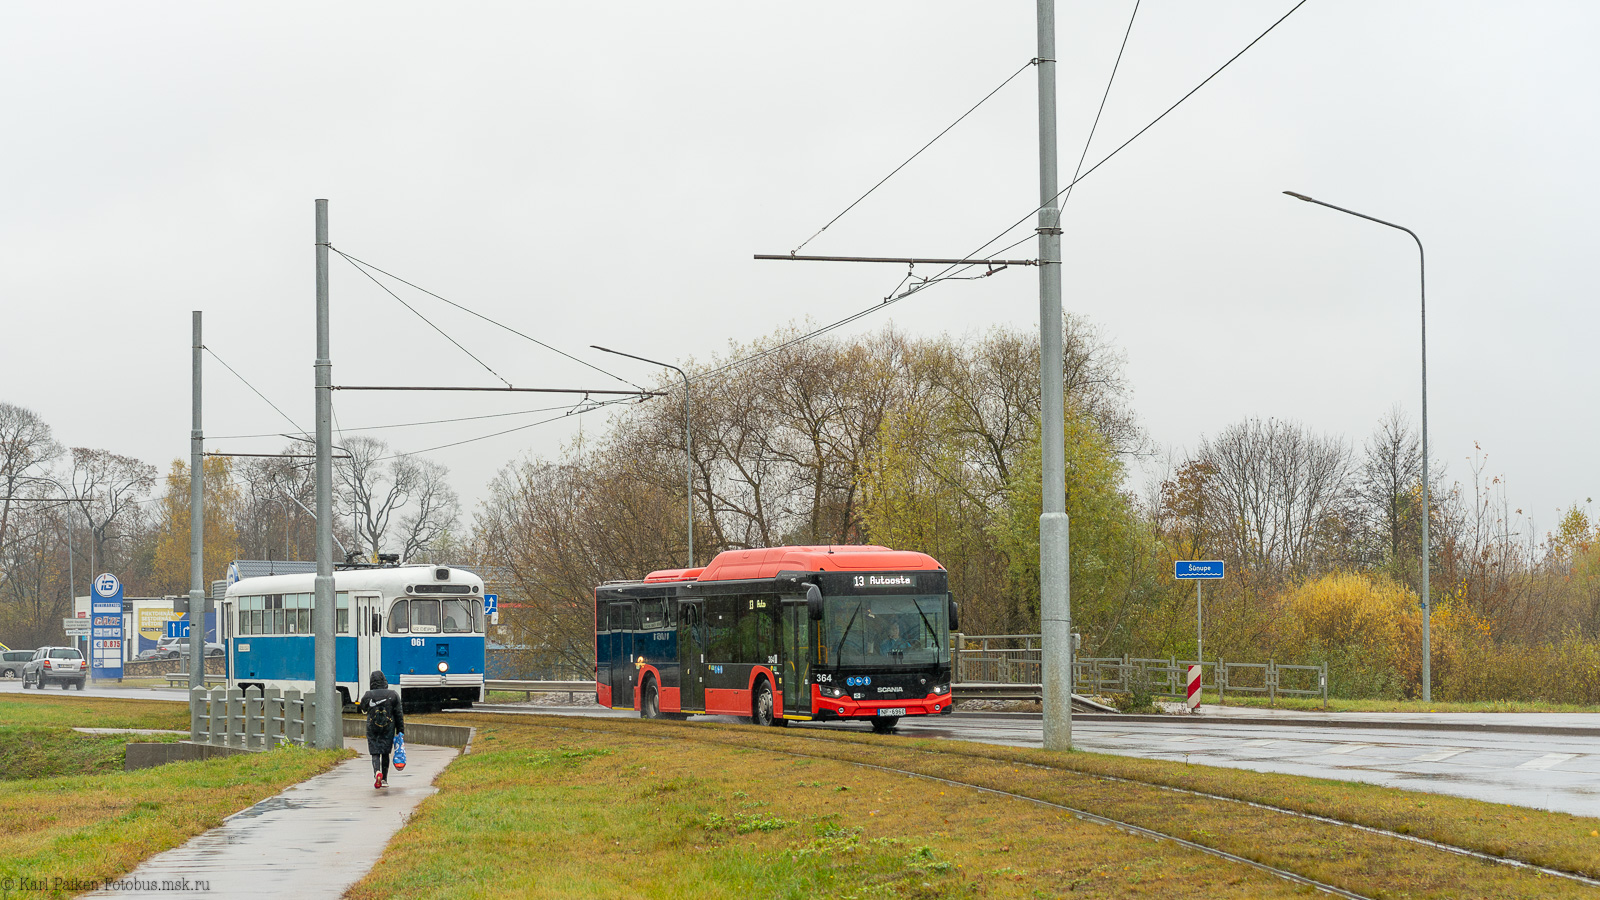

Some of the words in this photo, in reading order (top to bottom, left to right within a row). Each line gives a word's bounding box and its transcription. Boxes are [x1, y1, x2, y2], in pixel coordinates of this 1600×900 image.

[853, 575, 864, 587] 13
[869, 575, 911, 585] Autoosta
[411, 638, 425, 647] 061
[816, 673, 832, 682] 364
